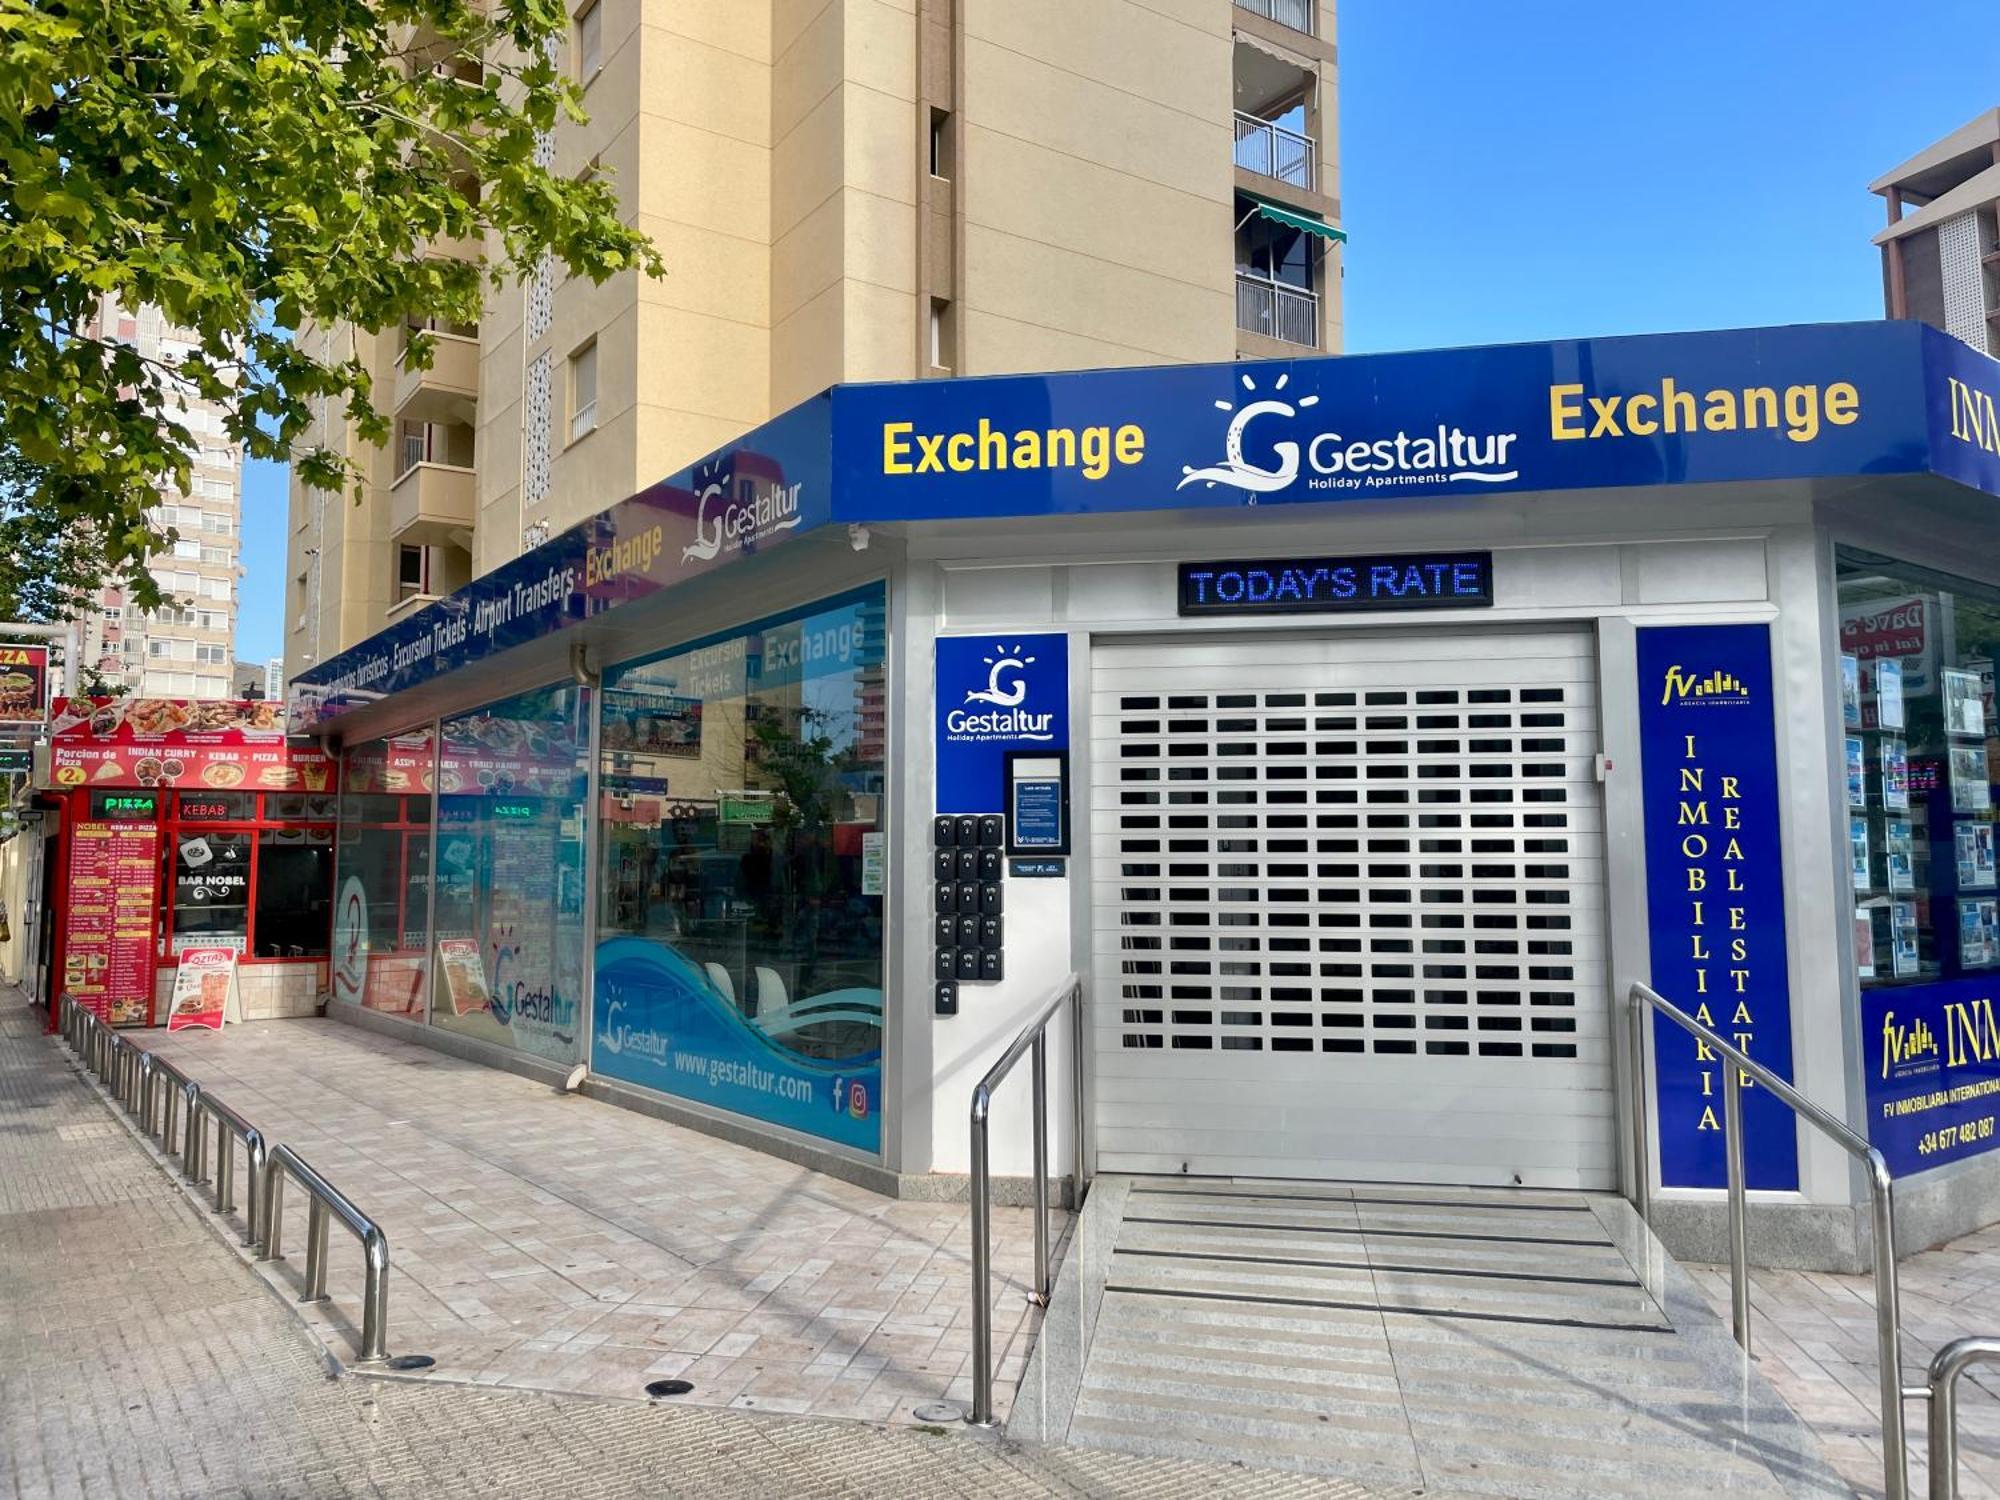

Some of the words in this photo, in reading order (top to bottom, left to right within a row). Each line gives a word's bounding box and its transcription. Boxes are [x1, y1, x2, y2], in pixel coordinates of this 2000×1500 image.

[1550, 377, 1860, 442] Exchange
[884, 418, 1145, 480] Exchange
[1308, 424, 1517, 474] Gestaltur
[1308, 475, 1361, 489] Holiday
[1365, 473, 1447, 488] Apartments
[724, 481, 802, 538] Gestaltur
[393, 632, 433, 671] Excursion
[433, 618, 466, 652] Tickets
[473, 591, 513, 638] Airport
[514, 567, 574, 617] Transfers
[586, 525, 662, 587] Exchange
[1190, 567, 1356, 602] TODAY'S
[1371, 563, 1479, 597] RATE
[0, 650, 30, 665] ZA
[764, 620, 865, 672] Exchange
[947, 707, 1053, 733] Gestaltur
[55, 757, 82, 766] Pizza
[102, 748, 117, 760] de
[128, 747, 162, 757] INDIAN
[164, 748, 197, 758] CURRY
[208, 752, 239, 761] KEBAB
[252, 753, 279, 762] PIZZA
[105, 798, 154, 810] PIZZA
[183, 804, 226, 816] KEBAB
[178, 876, 204, 885] BAR
[206, 876, 245, 886] NOBEL
[1677, 735, 1720, 1130] INMOBILIARIA
[624, 1024, 667, 1057] Gestaltur
[674, 1050, 812, 1104] www.gestaltur.com
[1884, 1102, 1895, 1118] FV
[1896, 1093, 1949, 1116] INMOBILIARIA
[1918, 1131, 1937, 1155] +34
[1939, 1125, 1957, 1151] 677
[1960, 1120, 1977, 1144] 482
[1979, 1116, 1995, 1140] 087
